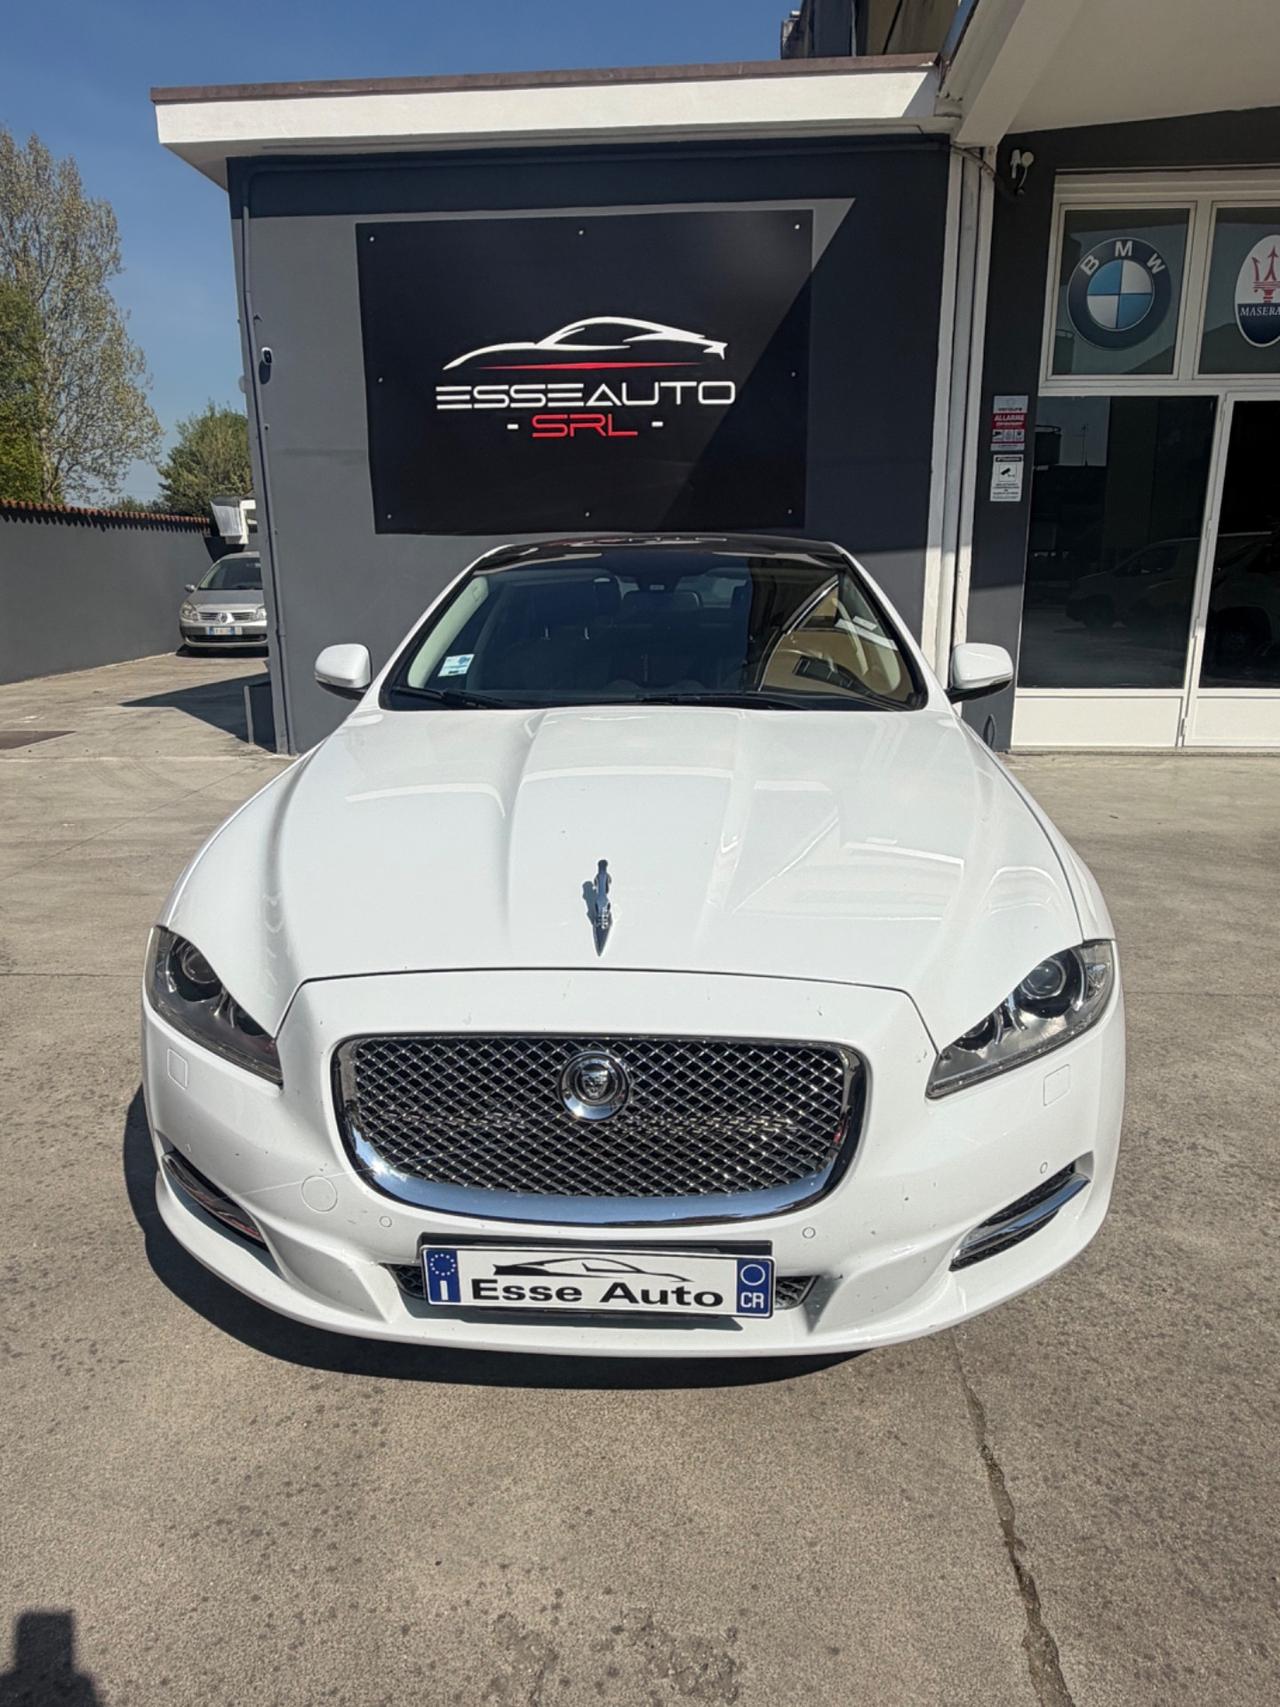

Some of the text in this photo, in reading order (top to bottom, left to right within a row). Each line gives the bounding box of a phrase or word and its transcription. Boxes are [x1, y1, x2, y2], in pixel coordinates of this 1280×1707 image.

[1080, 240, 1166, 276] BMW
[435, 381, 736, 409] ESSEAUTO
[531, 413, 638, 438] SRL
[471, 1278, 724, 1308] Esse Auto
[740, 1292, 765, 1310] CR
